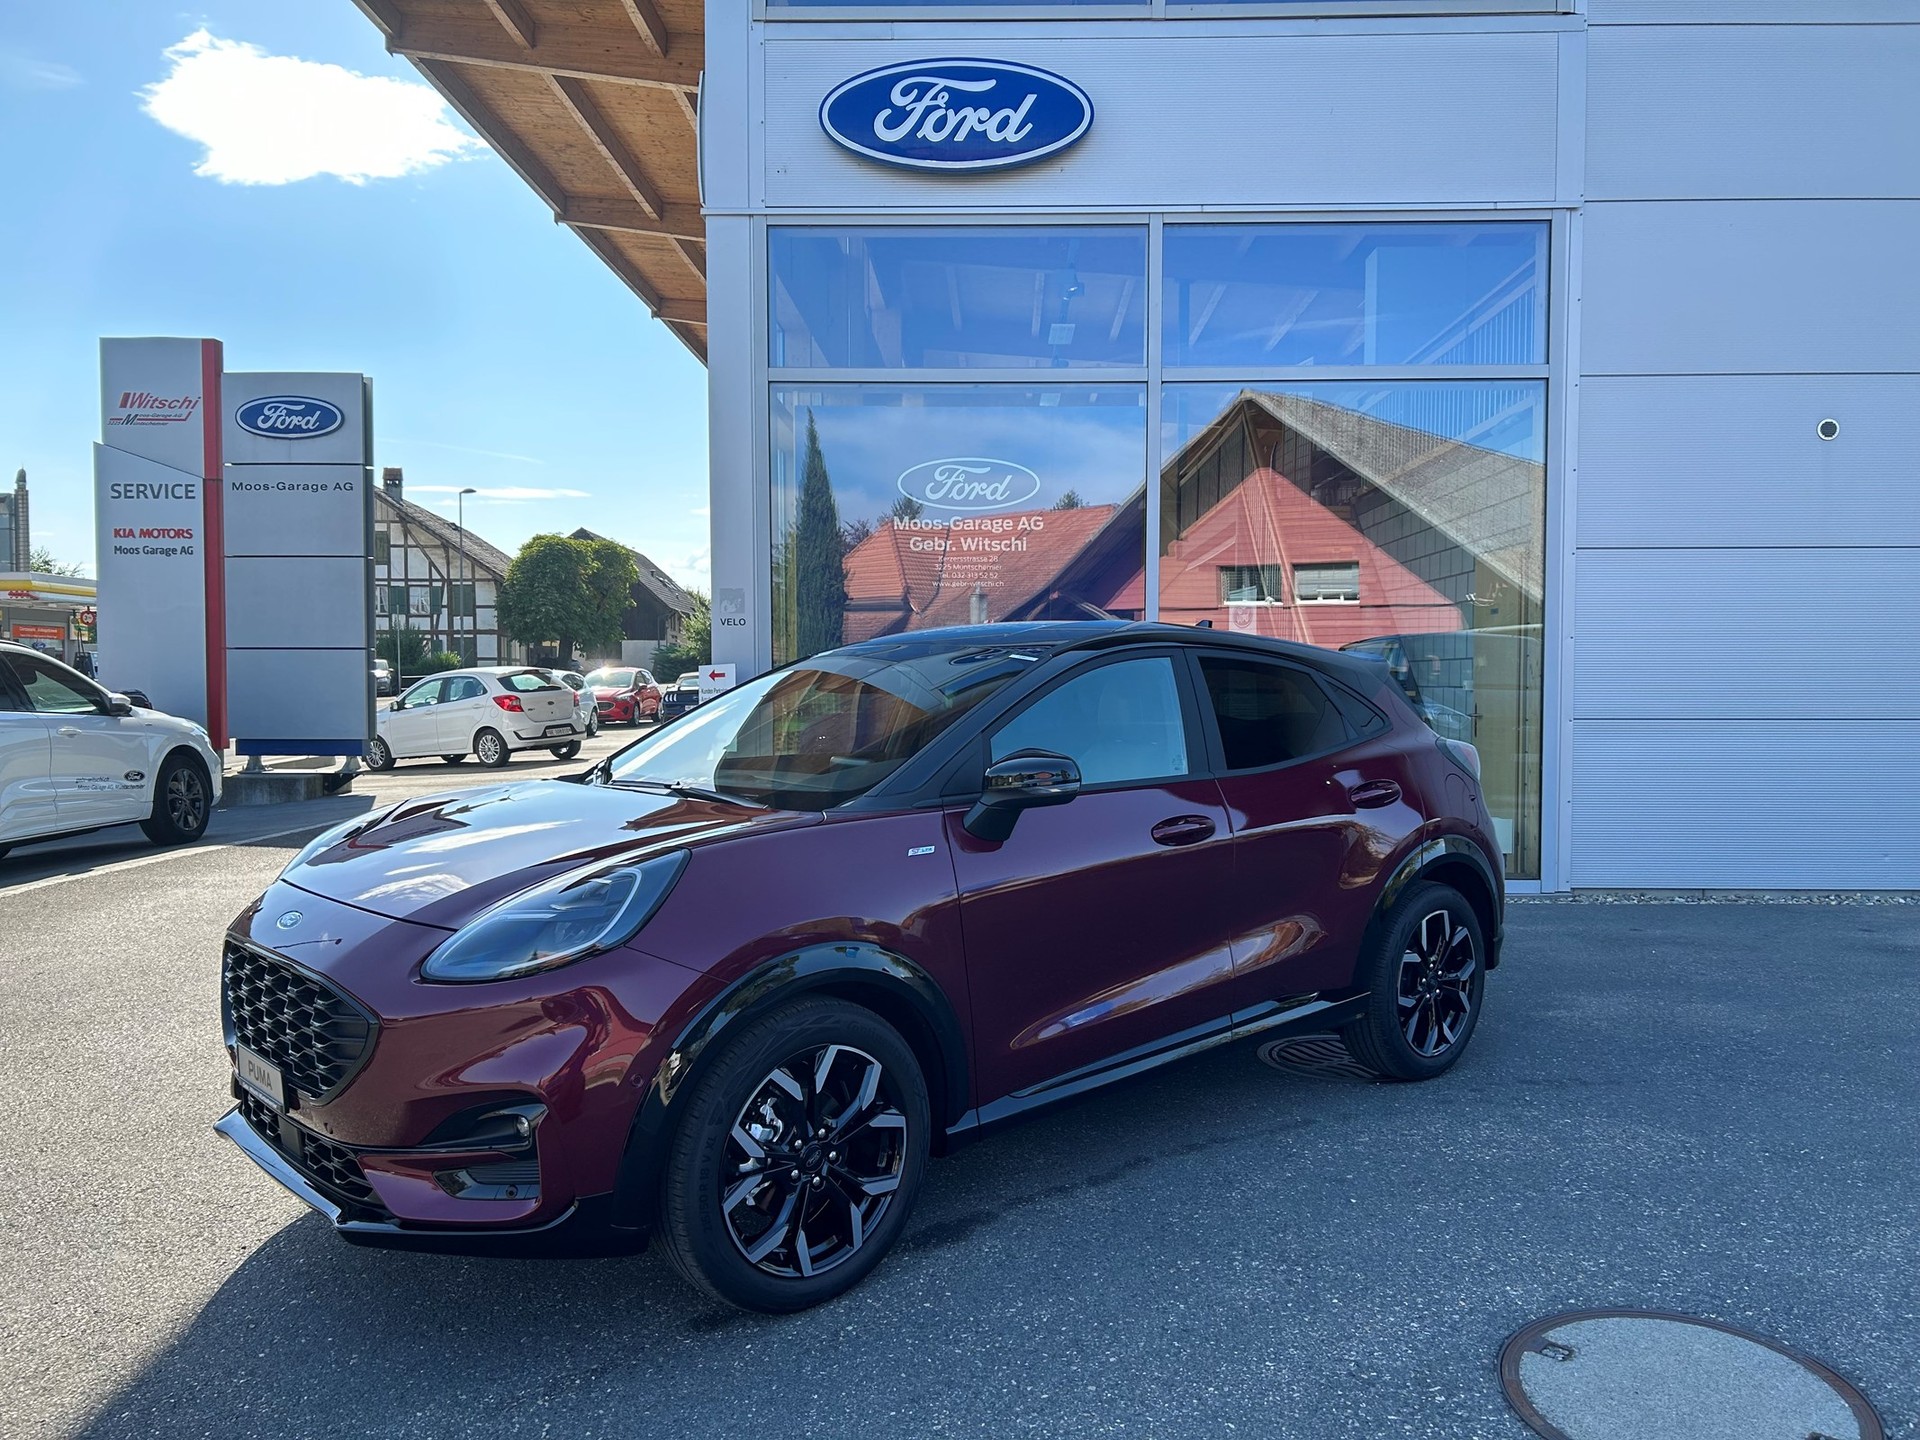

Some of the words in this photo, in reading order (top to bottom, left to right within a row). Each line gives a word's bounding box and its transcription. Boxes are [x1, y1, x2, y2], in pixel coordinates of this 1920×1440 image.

[873, 76, 1038, 143] Ford
[128, 392, 202, 410] Witschi
[257, 403, 322, 430] Ford
[110, 482, 196, 500] SERVICE
[231, 481, 329, 493] Moos-Garage
[333, 481, 354, 492] AG
[925, 464, 1013, 501] Ford
[893, 515, 1013, 534] Moos-Garage
[1017, 515, 1044, 532] AG
[113, 527, 136, 539] KIA
[139, 527, 194, 540] MOTORS
[113, 545, 140, 555] Moos
[142, 545, 178, 557] Garage
[179, 545, 194, 555] AG
[909, 536, 957, 552] Gebr.
[960, 536, 1028, 552] Witschi
[988, 555, 999, 563] 28
[951, 571, 965, 579] 032
[966, 571, 978, 579] 313
[979, 571, 989, 579] 52
[720, 617, 746, 627] VELO
[247, 1059, 273, 1091] PUMA
